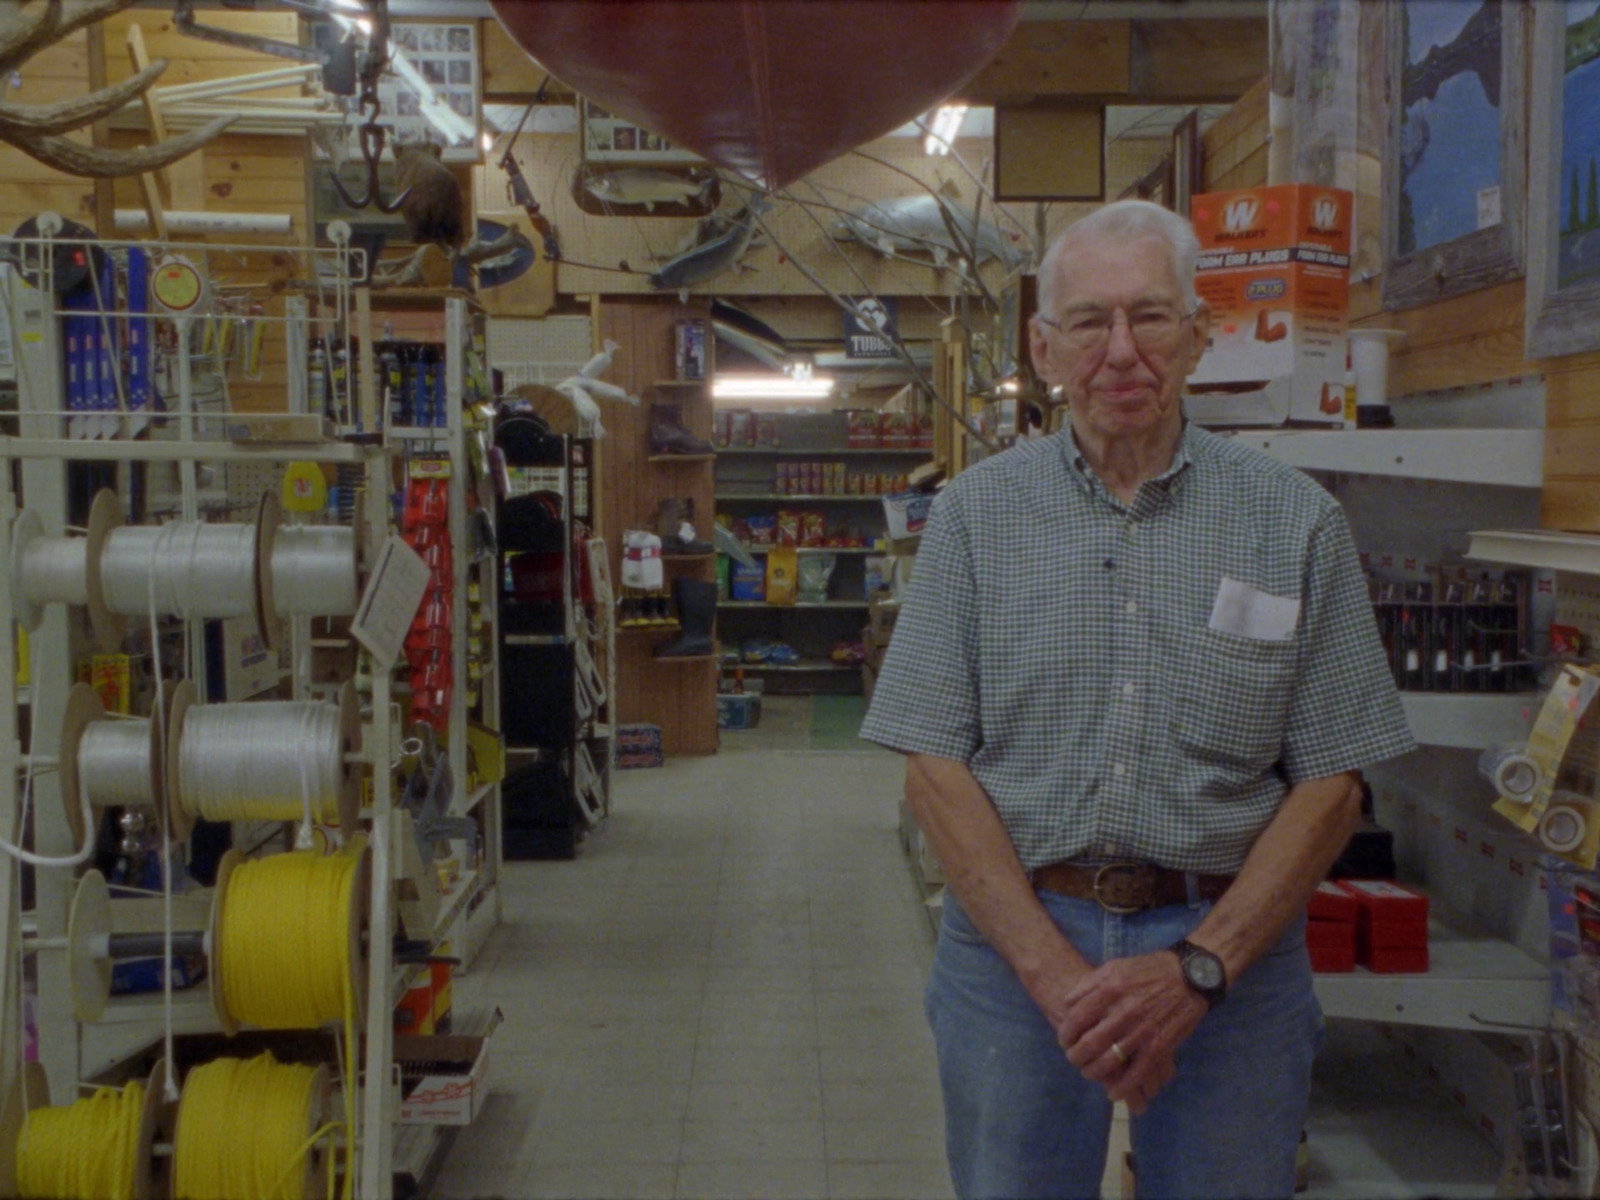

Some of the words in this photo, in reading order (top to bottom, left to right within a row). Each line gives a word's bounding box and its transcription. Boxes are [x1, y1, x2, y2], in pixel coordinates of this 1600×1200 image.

[1226, 201, 1258, 230] W
[1313, 200, 1337, 227] W
[1225, 252, 1248, 265] EAR
[1249, 249, 1289, 264] PLUGS
